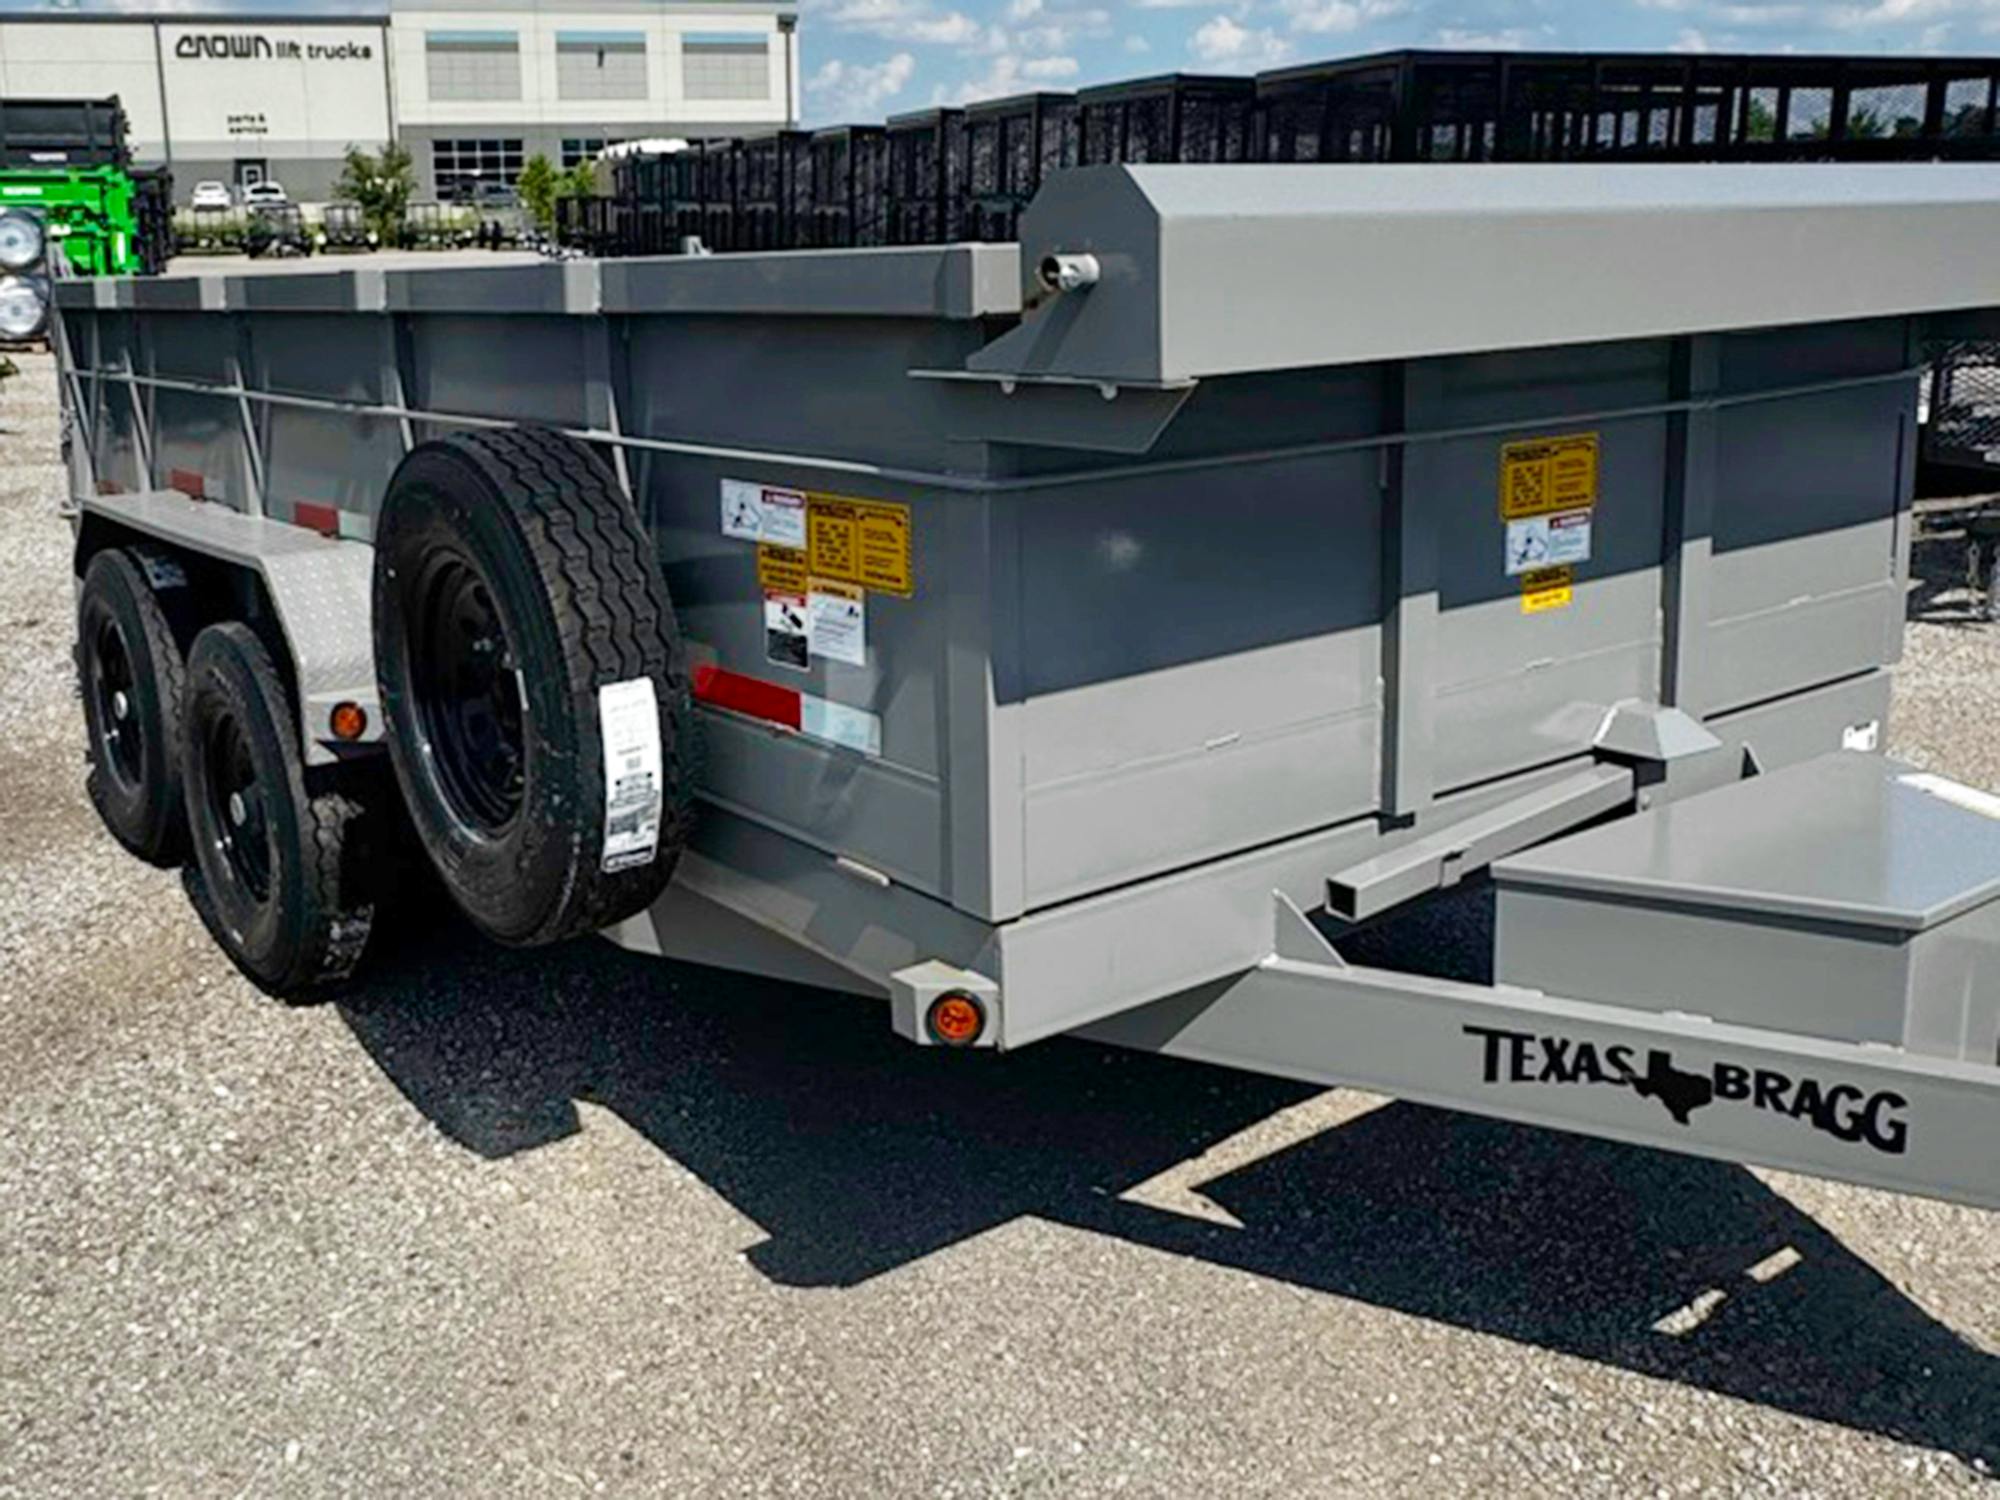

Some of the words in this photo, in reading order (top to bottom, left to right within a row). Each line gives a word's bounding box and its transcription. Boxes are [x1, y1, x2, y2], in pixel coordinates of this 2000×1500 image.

[175, 35, 272, 59] CROWN
[276, 41, 301, 59] lift
[307, 40, 372, 60] trucks
[227, 114, 255, 125] parts
[229, 126, 268, 135] service
[1462, 1024, 1636, 1085] TEXAS
[1712, 1062, 1909, 1155] BRAGG
